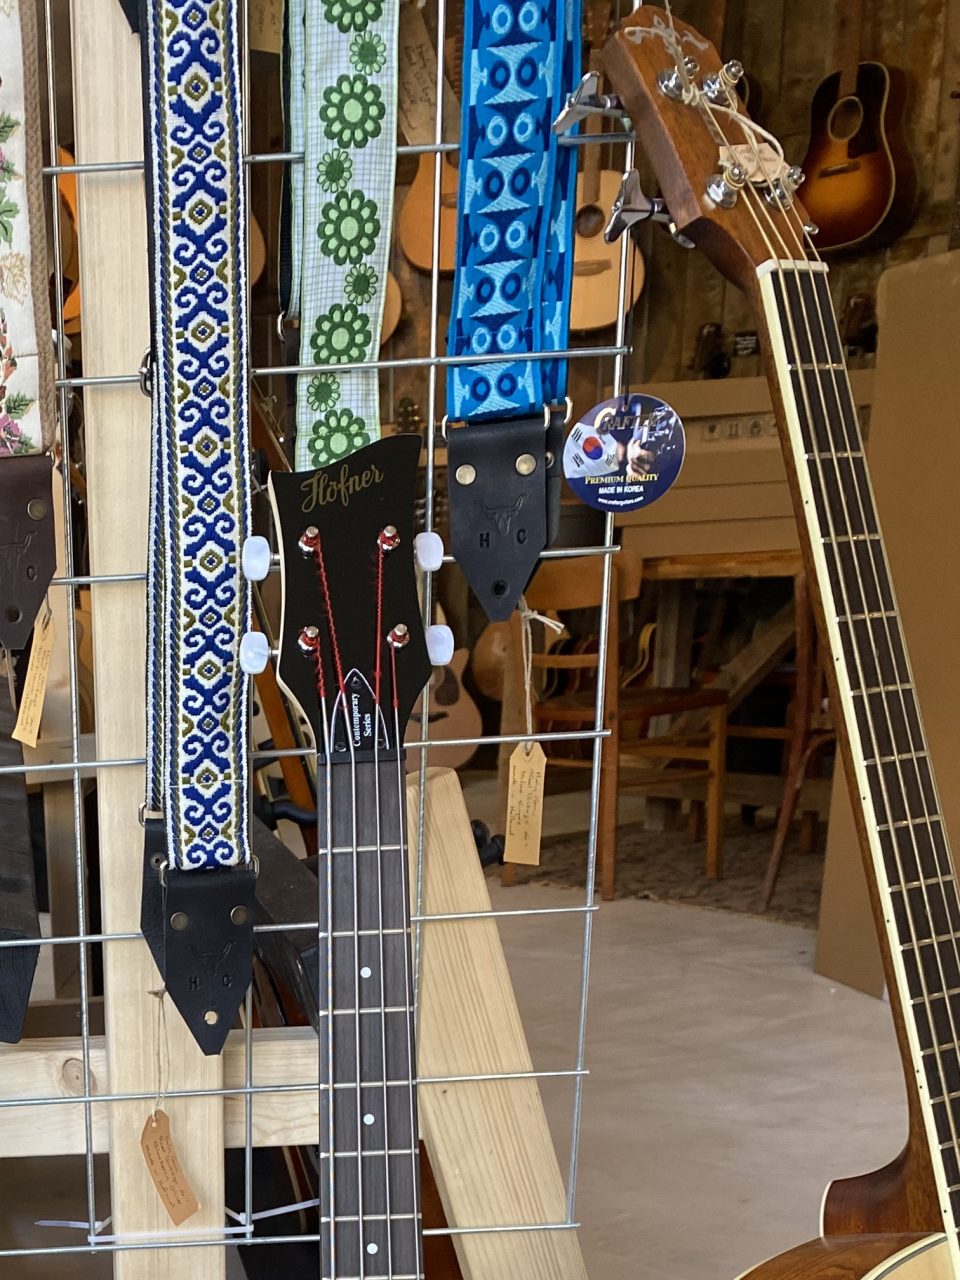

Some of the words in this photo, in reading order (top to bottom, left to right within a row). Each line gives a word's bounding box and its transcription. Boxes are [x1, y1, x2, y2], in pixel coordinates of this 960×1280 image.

[598, 486, 615, 495] MADE
[616, 486, 623, 494] IN
[623, 485, 644, 493] KOREA
[479, 531, 491, 549] H
[516, 529, 528, 546] C
[25, 565, 37, 581] C
[351, 693, 361, 747] Contemporary
[363, 713, 372, 737] Series
